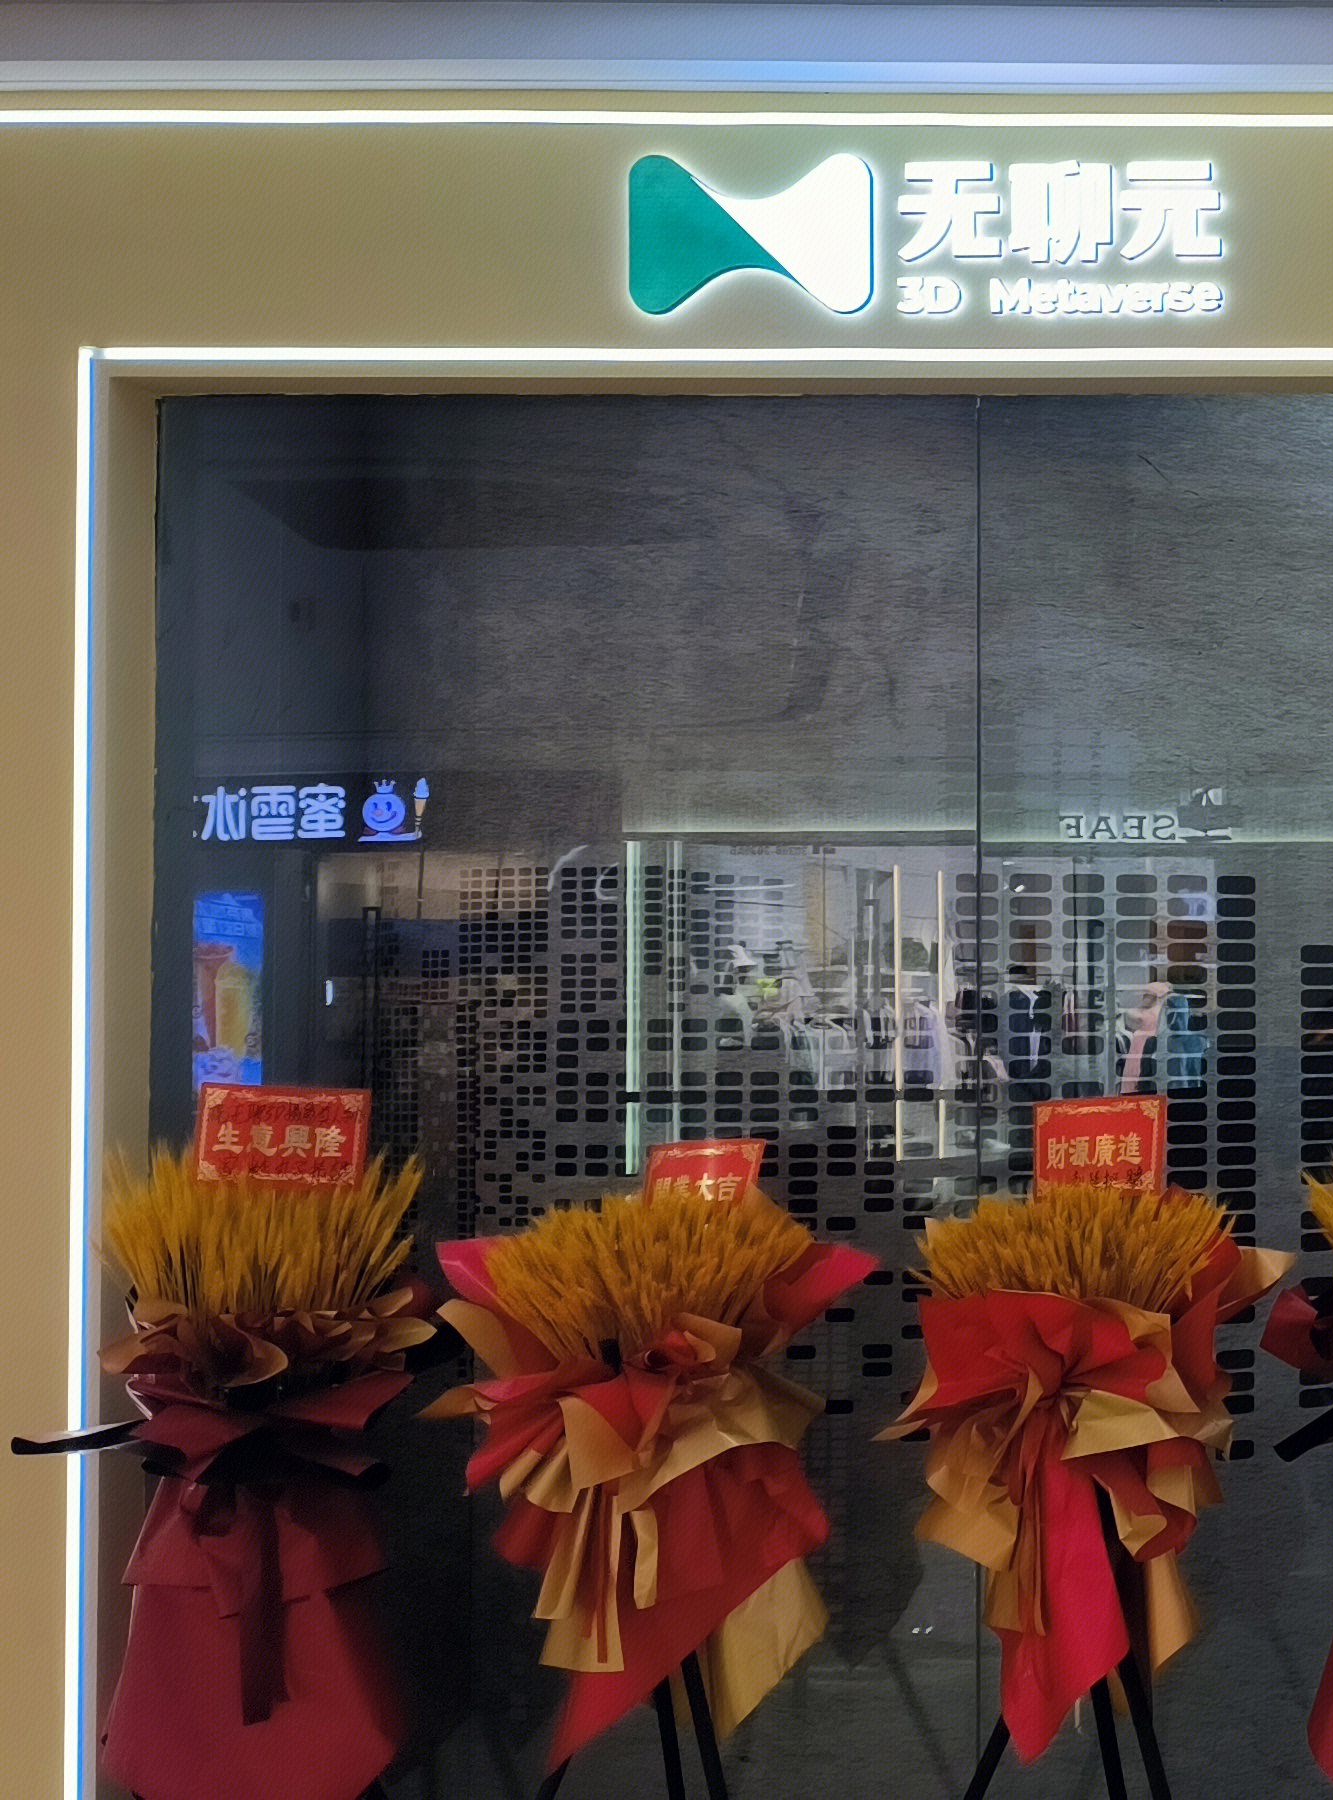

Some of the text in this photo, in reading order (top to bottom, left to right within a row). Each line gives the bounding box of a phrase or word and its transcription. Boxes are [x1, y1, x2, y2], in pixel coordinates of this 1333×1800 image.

[897, 160, 1221, 264] 无聊元
[897, 277, 1224, 316] 3D Metaverse
[212, 1121, 347, 1159] 生意興隆
[1046, 1131, 1143, 1170] 財源廣進
